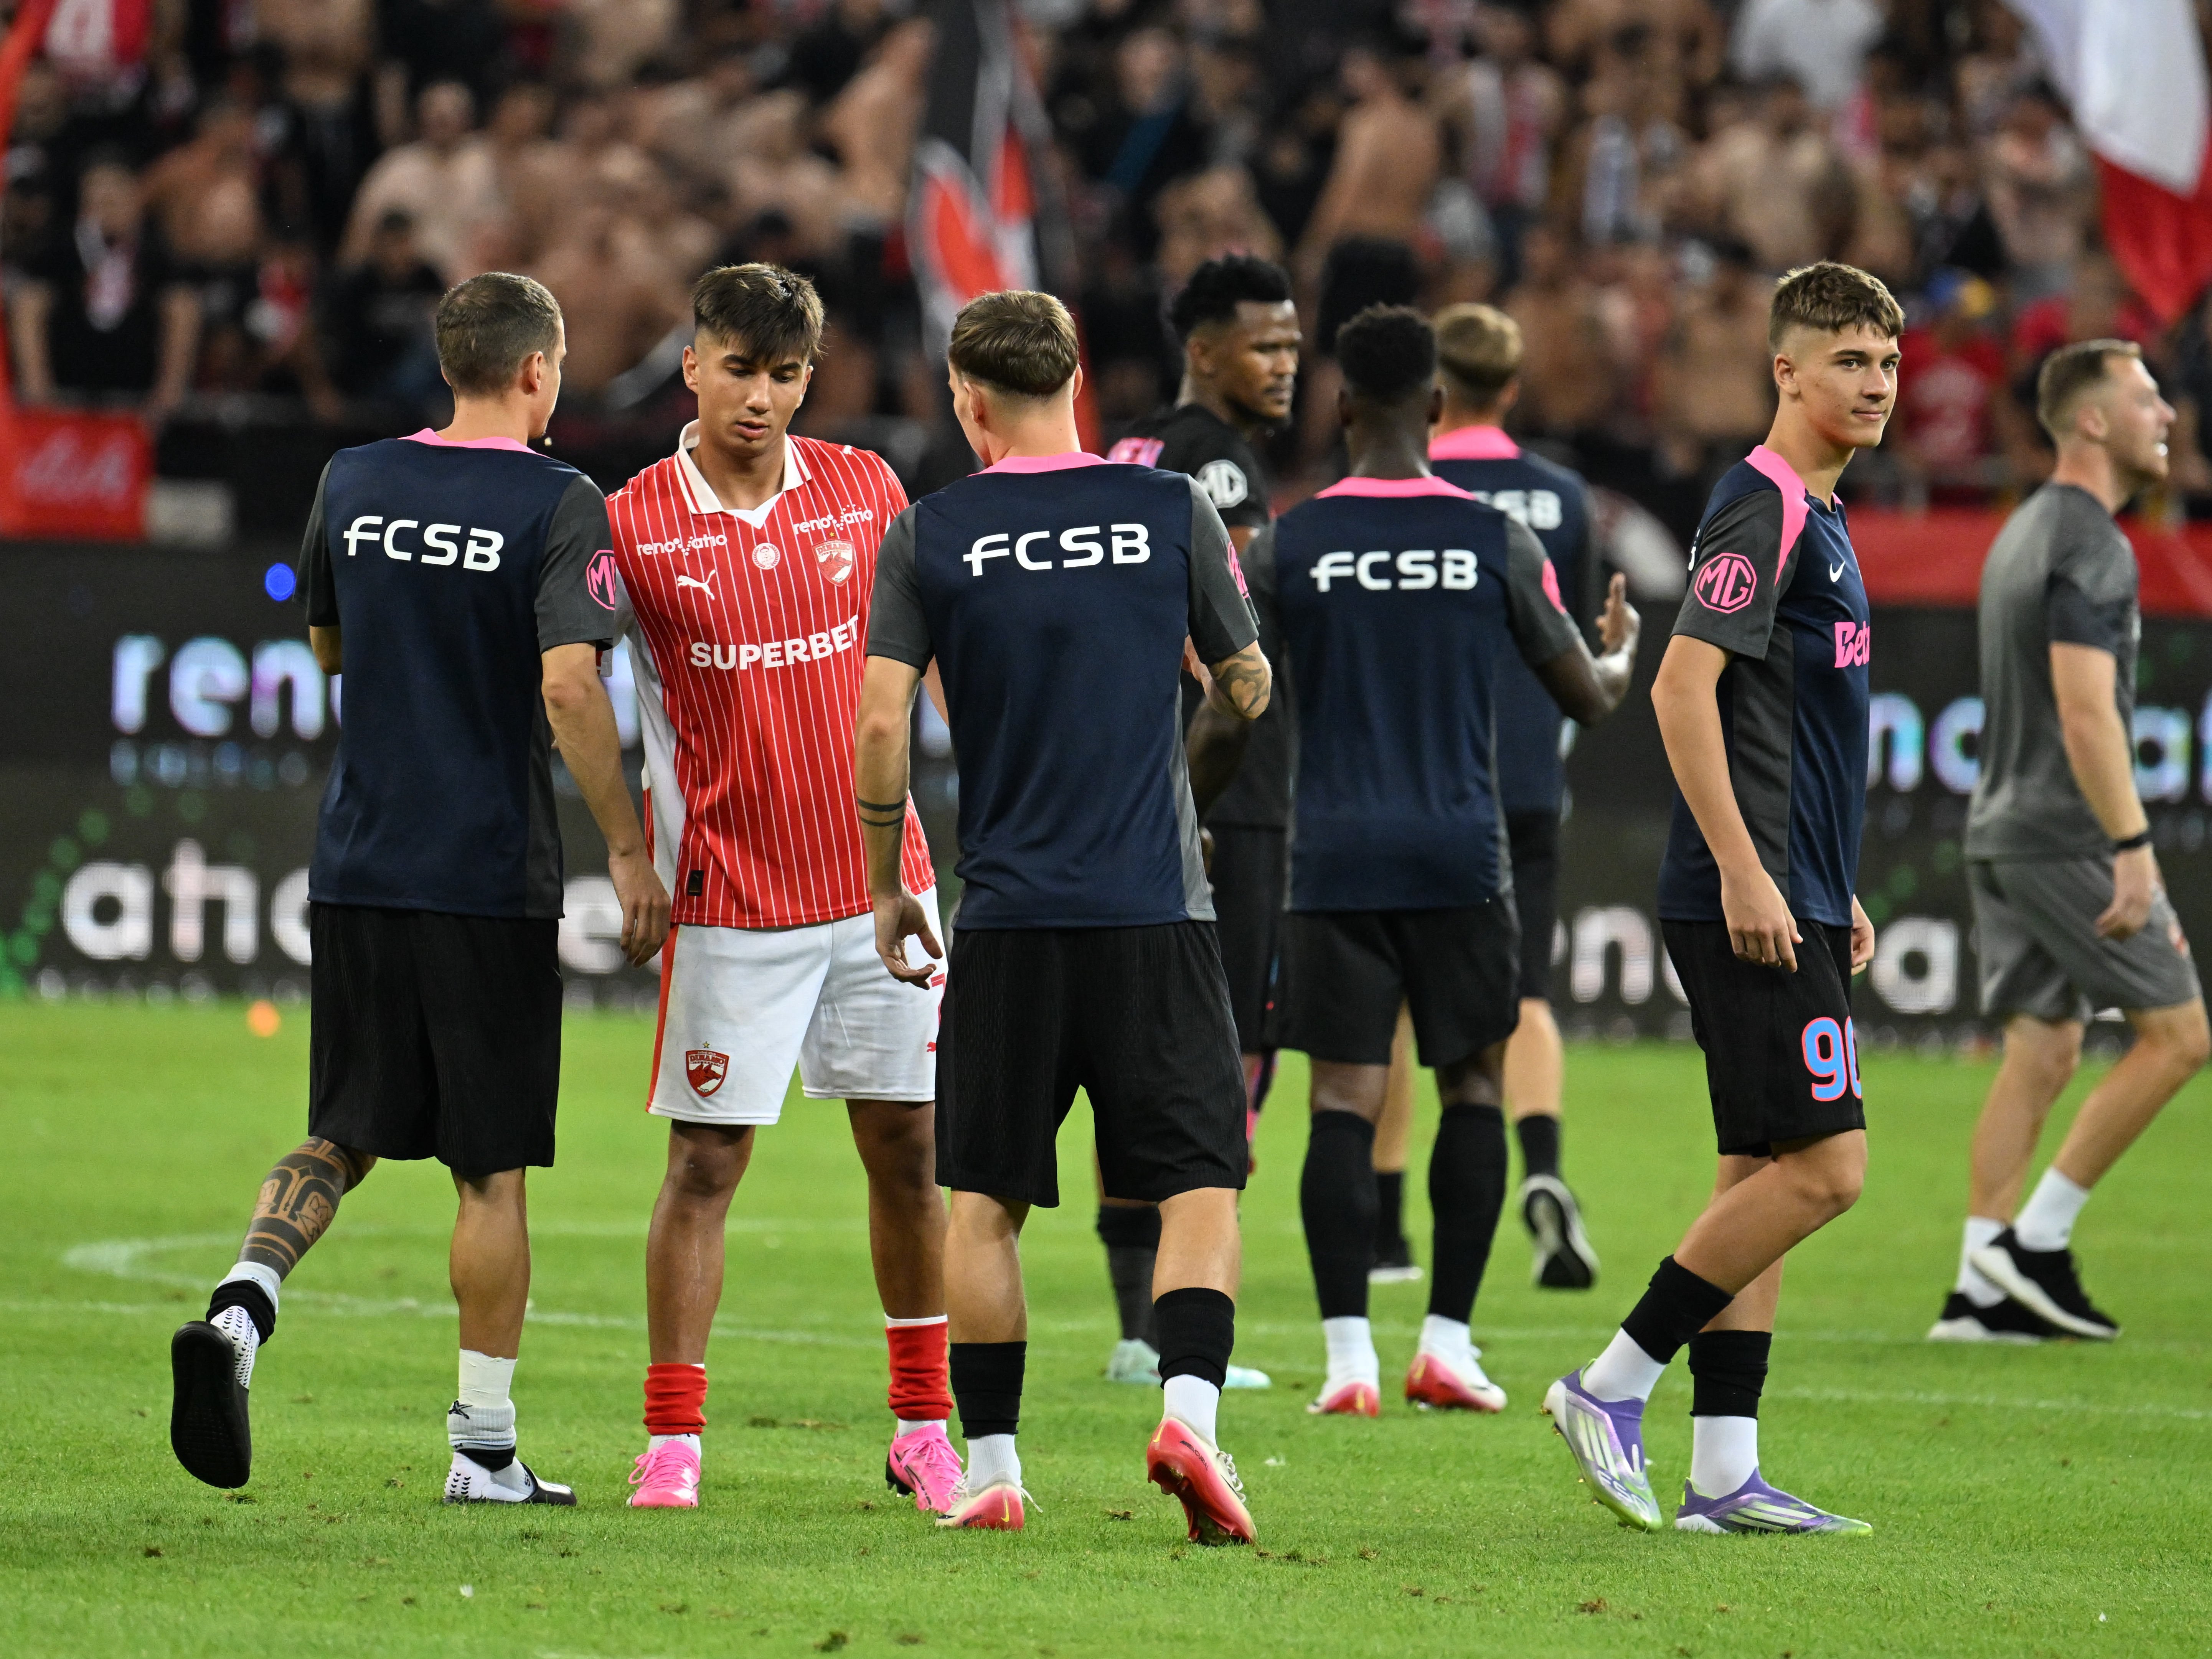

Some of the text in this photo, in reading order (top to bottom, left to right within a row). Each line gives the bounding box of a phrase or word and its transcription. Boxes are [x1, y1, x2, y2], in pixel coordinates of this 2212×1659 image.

[343, 516, 504, 572] FCSB
[963, 523, 1151, 577] FCSB
[1309, 549, 1478, 593] FCSB
[1700, 557, 1752, 608] MG
[691, 614, 859, 670] SUPERBET
[1179, 1440, 1209, 1471] MERCURIAL
